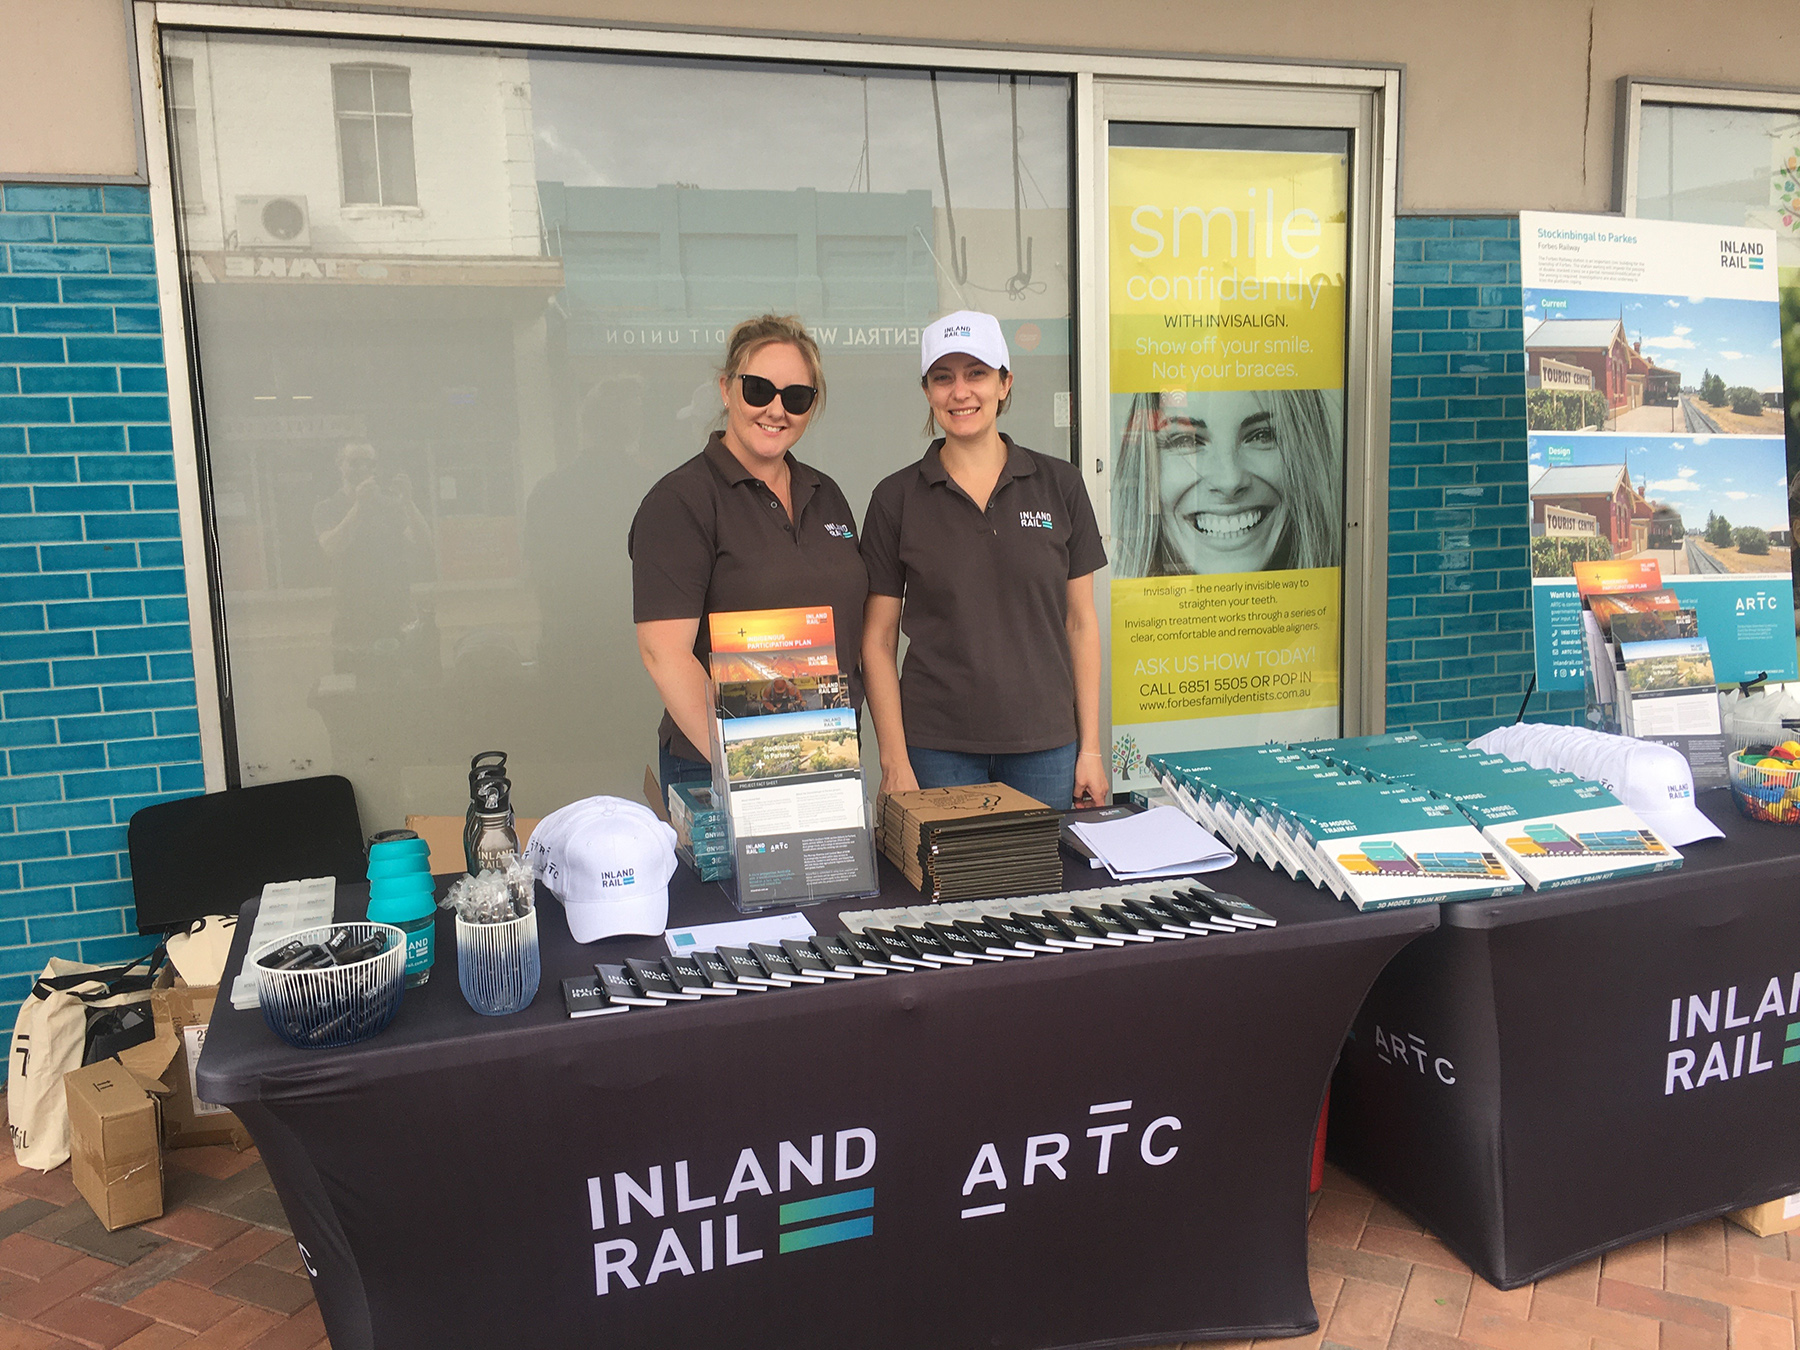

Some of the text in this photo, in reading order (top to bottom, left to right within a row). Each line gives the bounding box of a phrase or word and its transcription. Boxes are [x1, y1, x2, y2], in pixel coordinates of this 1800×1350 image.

[1129, 187, 1322, 260] smile
[1537, 228, 1638, 244] Stockinbingal to Parkes
[1538, 242, 1580, 252] Forbes Railway
[1720, 240, 1764, 256] INLAND
[1720, 255, 1747, 269] RAIL
[1126, 266, 1324, 309] confidently
[1541, 298, 1567, 308] Current
[1164, 314, 1289, 328] WITH INVISALIGN.
[944, 326, 971, 334] INLAND
[1135, 335, 1314, 358] Show off your smile.
[1152, 359, 1299, 382] Not your braces.
[1542, 366, 1590, 385] TOURIST CENTRE
[1548, 446, 1571, 456] Design
[1019, 511, 1052, 522] INLAND
[1020, 518, 1042, 528] RAIL
[1547, 514, 1595, 532] TOURIST CENTRE
[1143, 579, 1309, 598] Invisalign the nearly invisible way to
[1178, 594, 1278, 610] straighten your teeth.
[1736, 592, 1777, 616] ARTC
[806, 612, 828, 620] INLAND
[1124, 617, 1167, 629] Invisalign
[1168, 614, 1217, 626] treatment
[1218, 612, 1246, 623] works
[1247, 610, 1283, 623] through
[1290, 608, 1316, 619] series
[1316, 606, 1327, 617] of
[1130, 621, 1320, 643] clear, comfortable and removable aligners.
[747, 634, 785, 642] INDIGENOUS
[747, 640, 794, 649] PARTICIPATION
[1133, 646, 1316, 676] ASK US HOW TODAY!
[818, 682, 838, 690] INLAND
[1139, 671, 1312, 697] CALL 6851 5505 OR POP IN
[1139, 688, 1311, 711] www.forbesfamilydentists.com.au
[763, 744, 800, 752] Stockinbingal
[764, 752, 790, 760] to Parkes
[1479, 758, 1504, 766] INLAND
[1502, 766, 1527, 774] INLAND
[1548, 777, 1574, 785] INLAND
[1574, 786, 1600, 794] INLAND
[1667, 783, 1689, 792] INLAND
[1399, 796, 1426, 804] INLAND
[1462, 793, 1487, 801] MODEL
[1668, 791, 1684, 800] RAIL
[1422, 804, 1450, 812] INLAND
[1490, 804, 1514, 813] MODEL
[1486, 812, 1506, 820] TRAIN
[1329, 819, 1354, 827] MODEL
[1322, 826, 1345, 834] TRAIN
[746, 842, 766, 850] INLAND
[770, 841, 789, 852] ARTC
[478, 848, 516, 860] INLAND
[478, 860, 502, 870] RAIL
[600, 868, 635, 880] INLAND
[1328, 860, 1338, 875] MODEL
[1340, 875, 1350, 889] TRAIN
[1560, 878, 1582, 887] MODEL
[1583, 875, 1602, 883] TRAIN
[1602, 872, 1614, 880] KIT
[602, 878, 623, 888] RAIL
[1387, 898, 1410, 908] MODEL
[1412, 896, 1435, 905] TRAIN
[408, 938, 428, 950] AND
[1375, 1024, 1457, 1086] ARTC
[1664, 1030, 1773, 1096] RAIL
[961, 1100, 1182, 1219] ARTC
[587, 1127, 877, 1230] INLAND
[593, 1214, 764, 1296] RAIL
